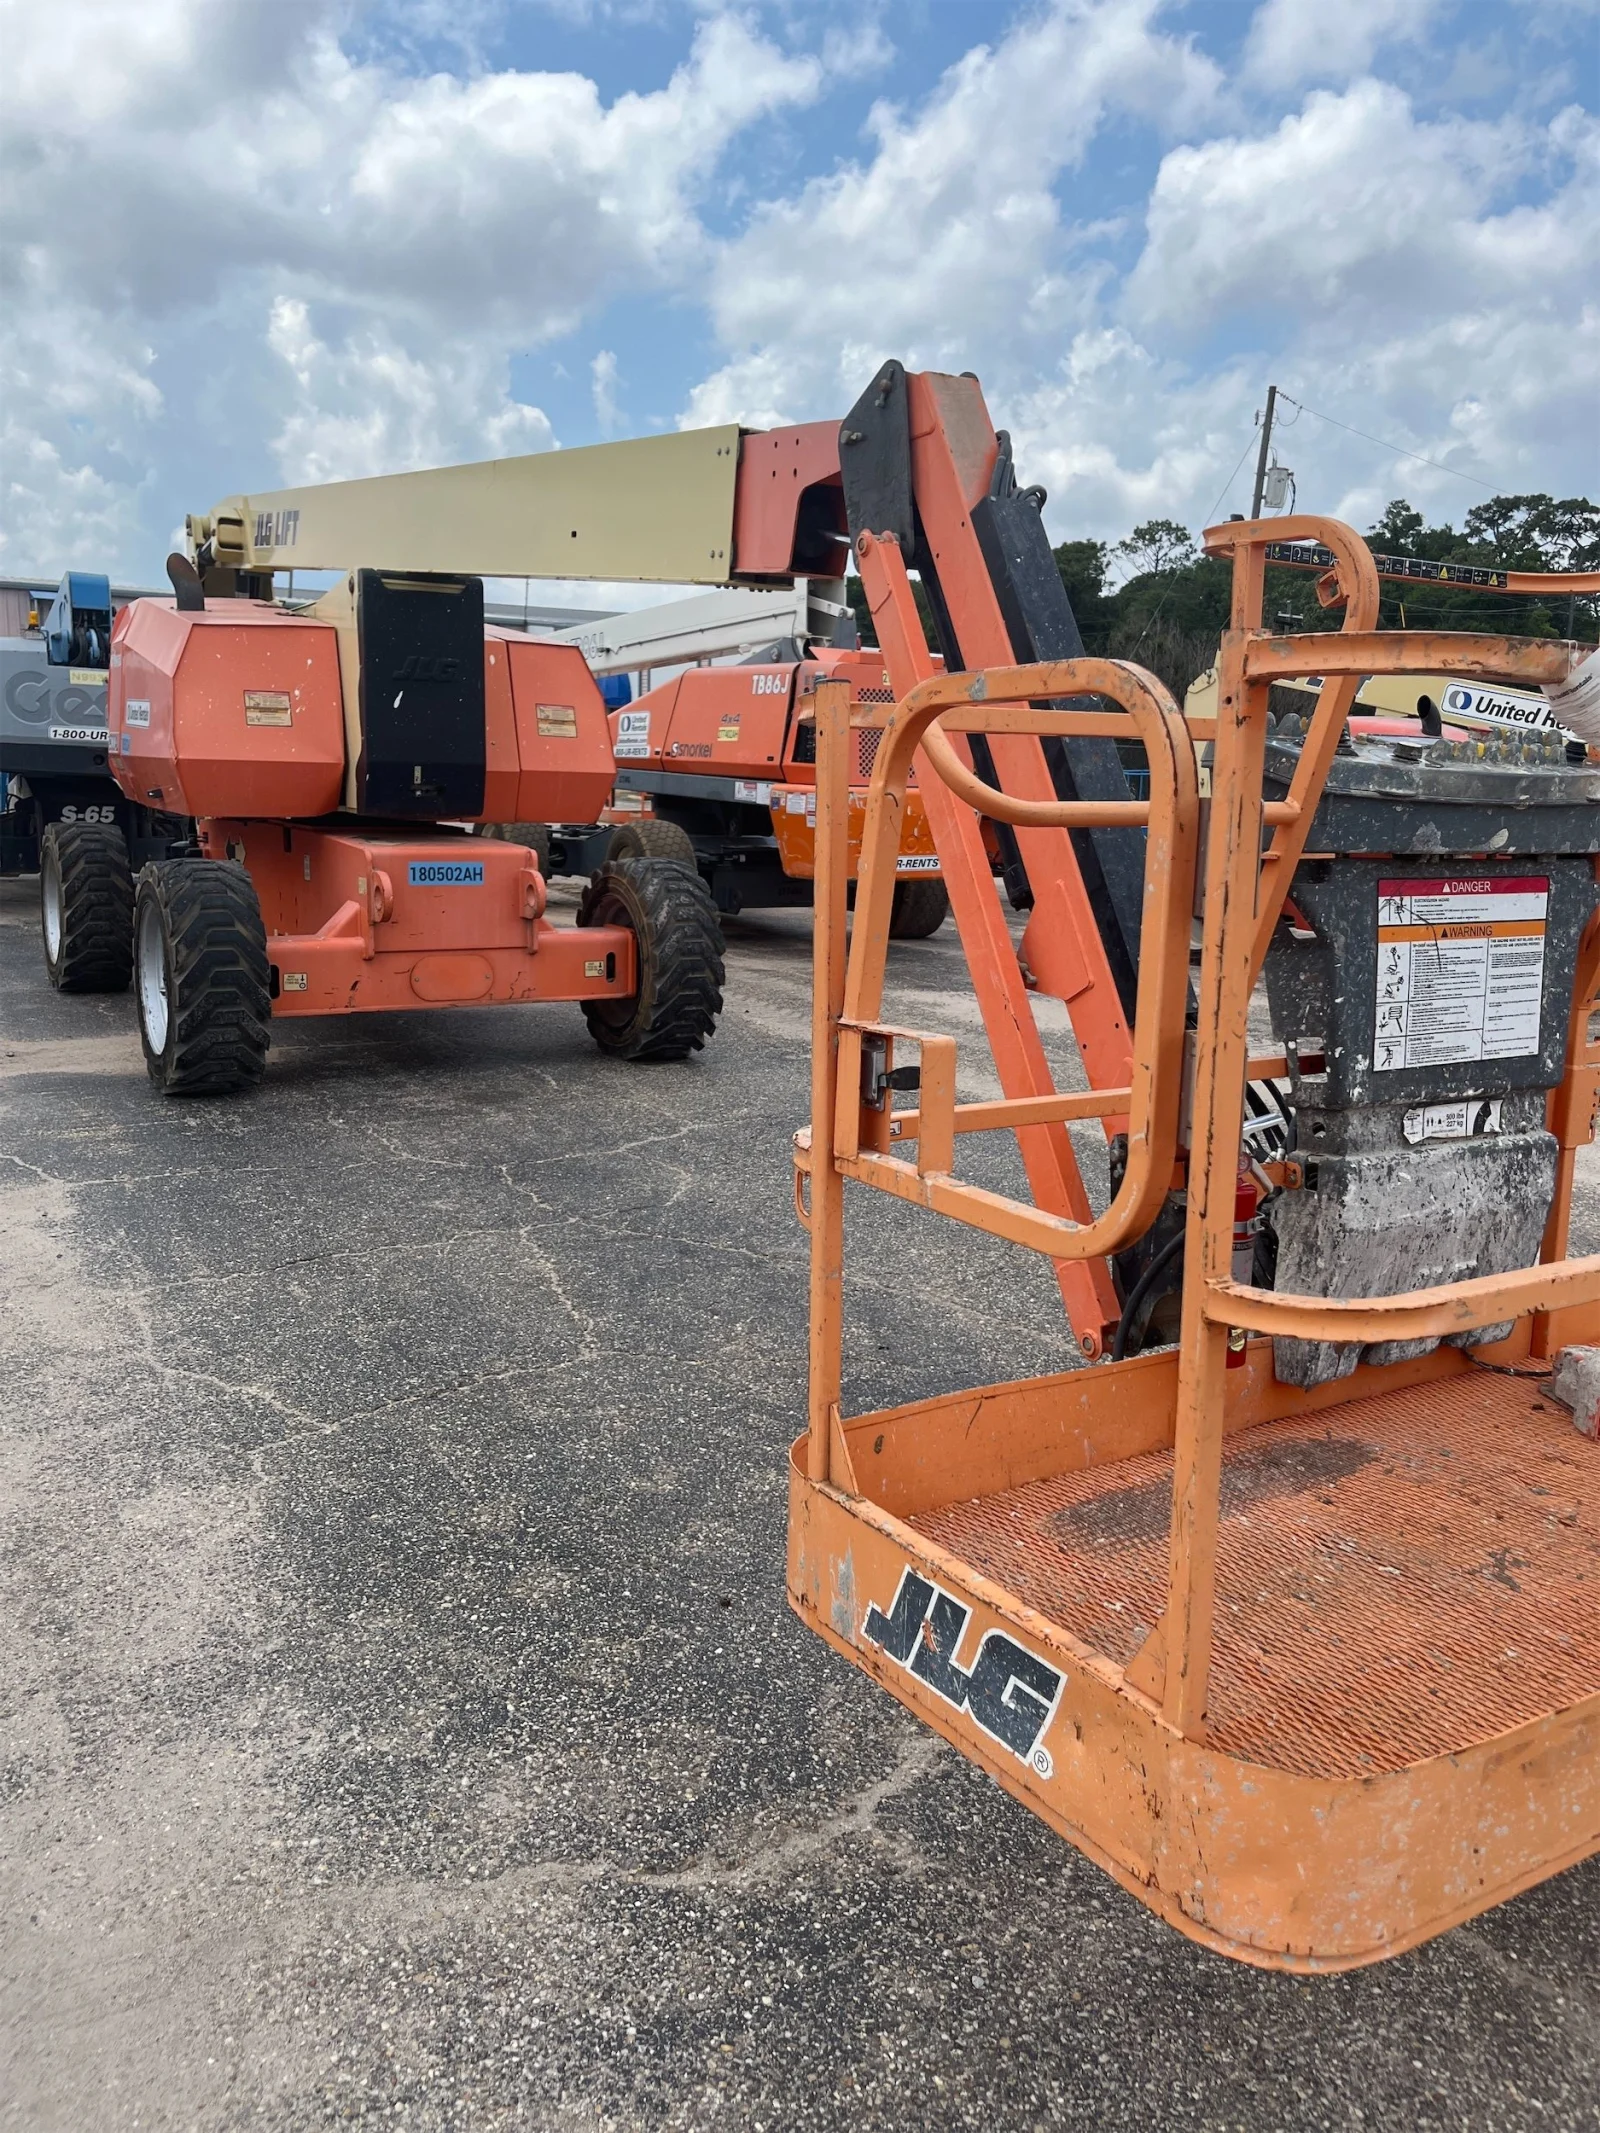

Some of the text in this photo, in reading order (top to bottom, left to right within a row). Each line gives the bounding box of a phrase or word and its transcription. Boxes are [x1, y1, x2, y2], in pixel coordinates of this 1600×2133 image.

[274, 510, 300, 546] LIFT
[751, 674, 791, 695] TB86J
[5, 670, 109, 726] Ge
[1475, 695, 1542, 725] United
[52, 729, 108, 740] 1-800-UR
[60, 804, 116, 824] S-65
[410, 866, 483, 882] 180502AH
[1452, 881, 1491, 893] DANGER
[1449, 925, 1493, 938] WARNING
[861, 1567, 1066, 1766] JLG
